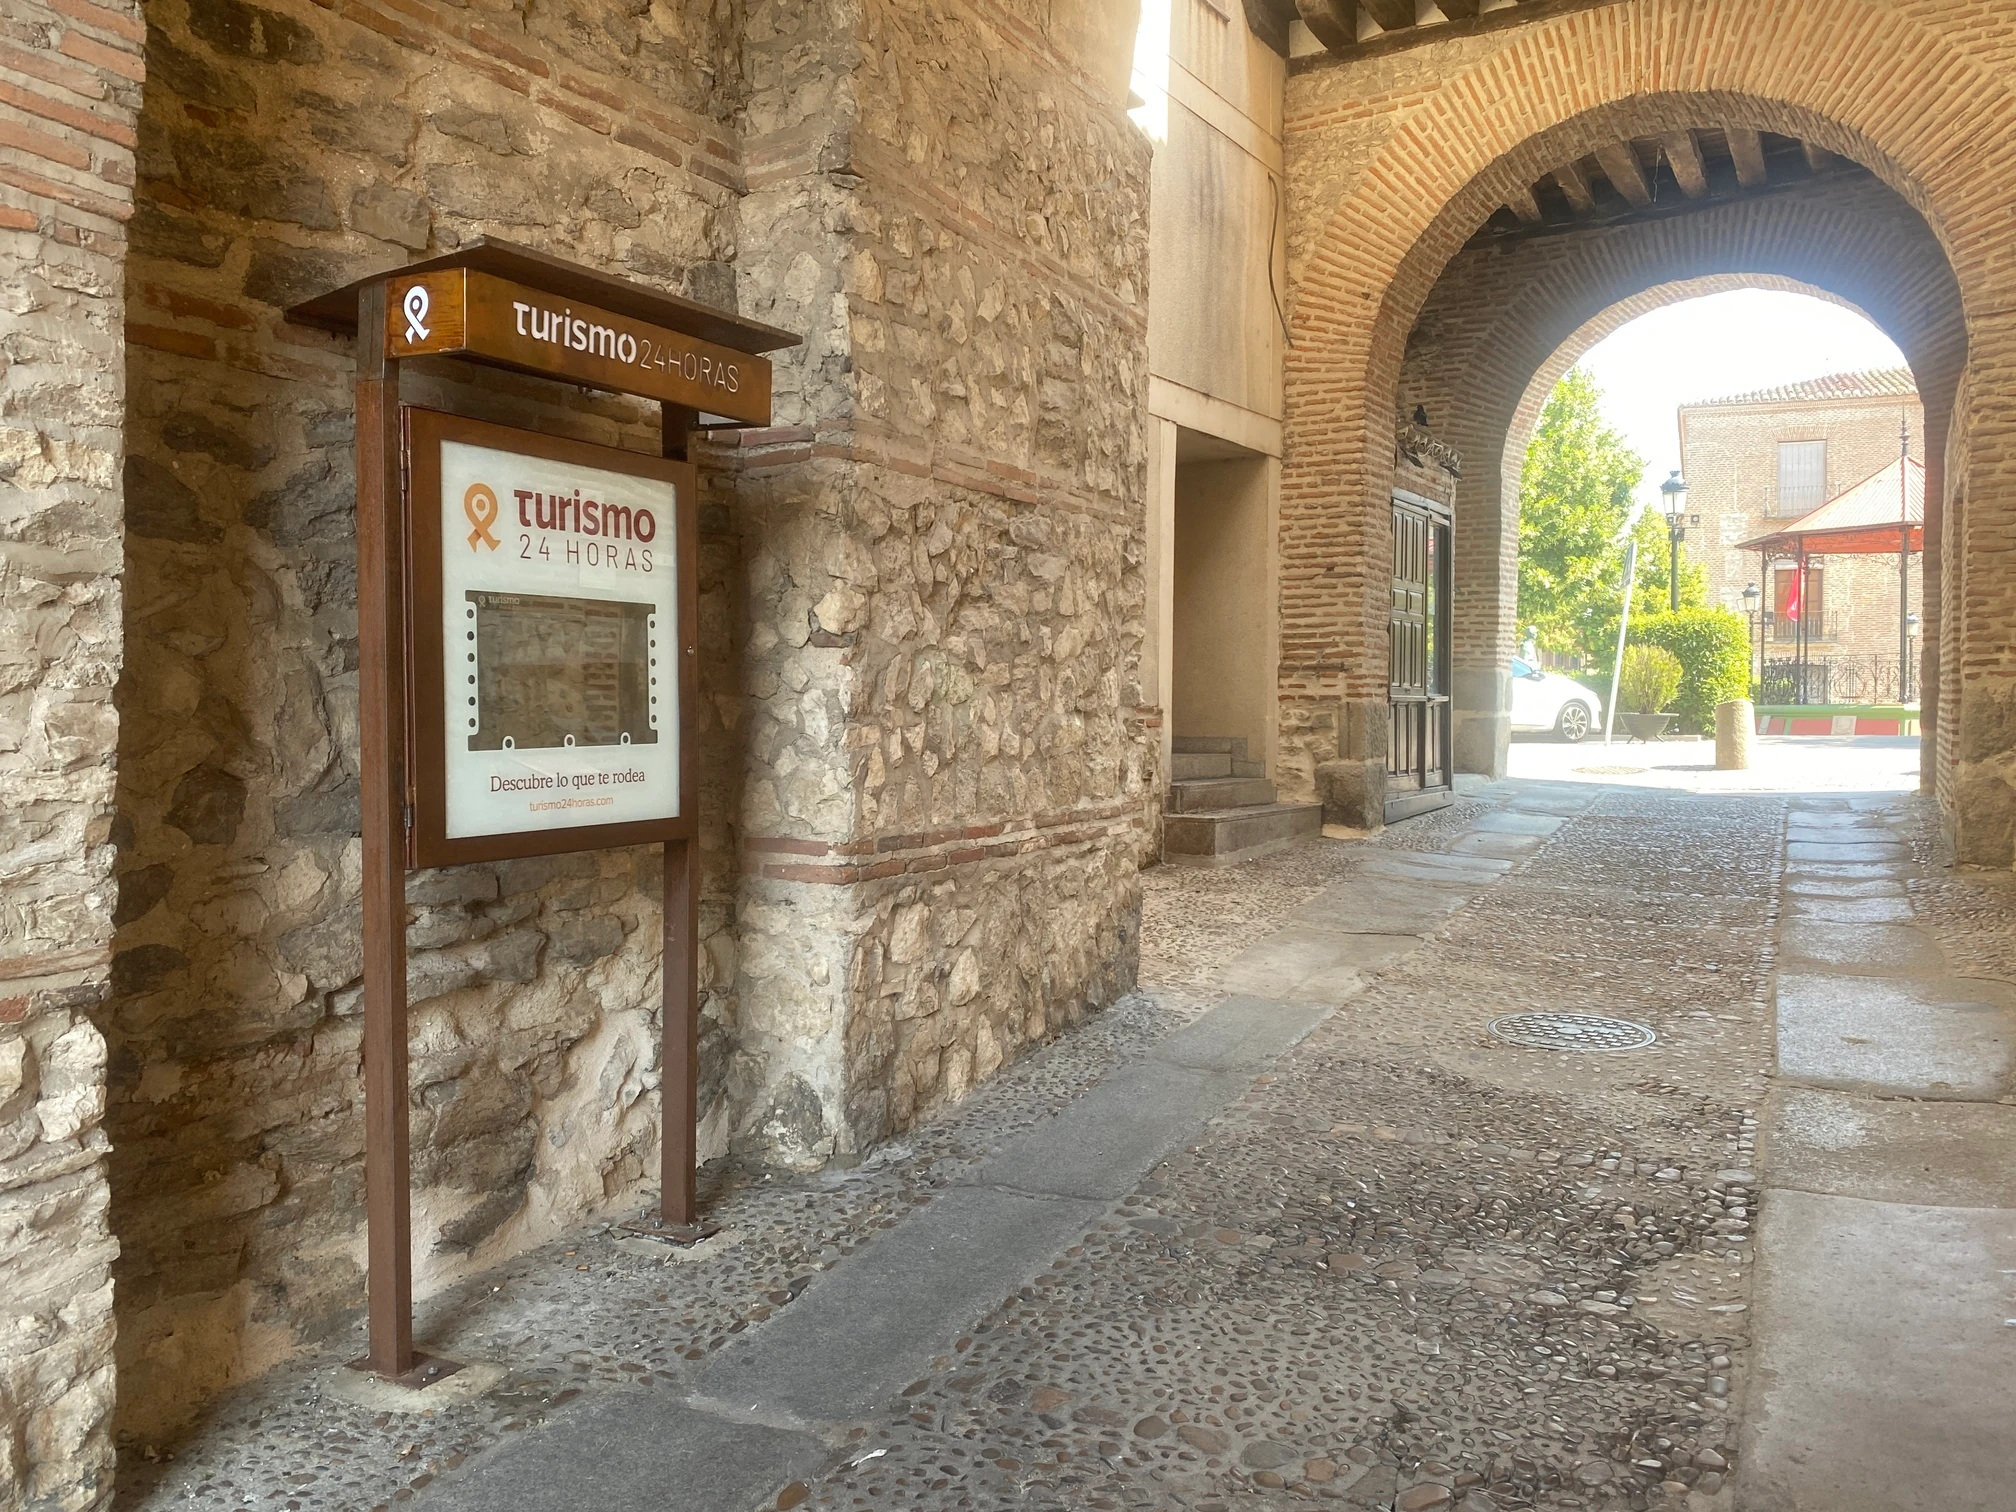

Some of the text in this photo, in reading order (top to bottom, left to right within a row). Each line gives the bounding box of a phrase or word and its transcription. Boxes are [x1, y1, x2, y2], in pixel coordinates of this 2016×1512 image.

[514, 489, 655, 542] turismo
[520, 534, 654, 572] 24 HORAS
[488, 595, 520, 605] turismo
[490, 769, 645, 792] Descubre lo que te rodea
[529, 797, 614, 811] turismo24horas.com
